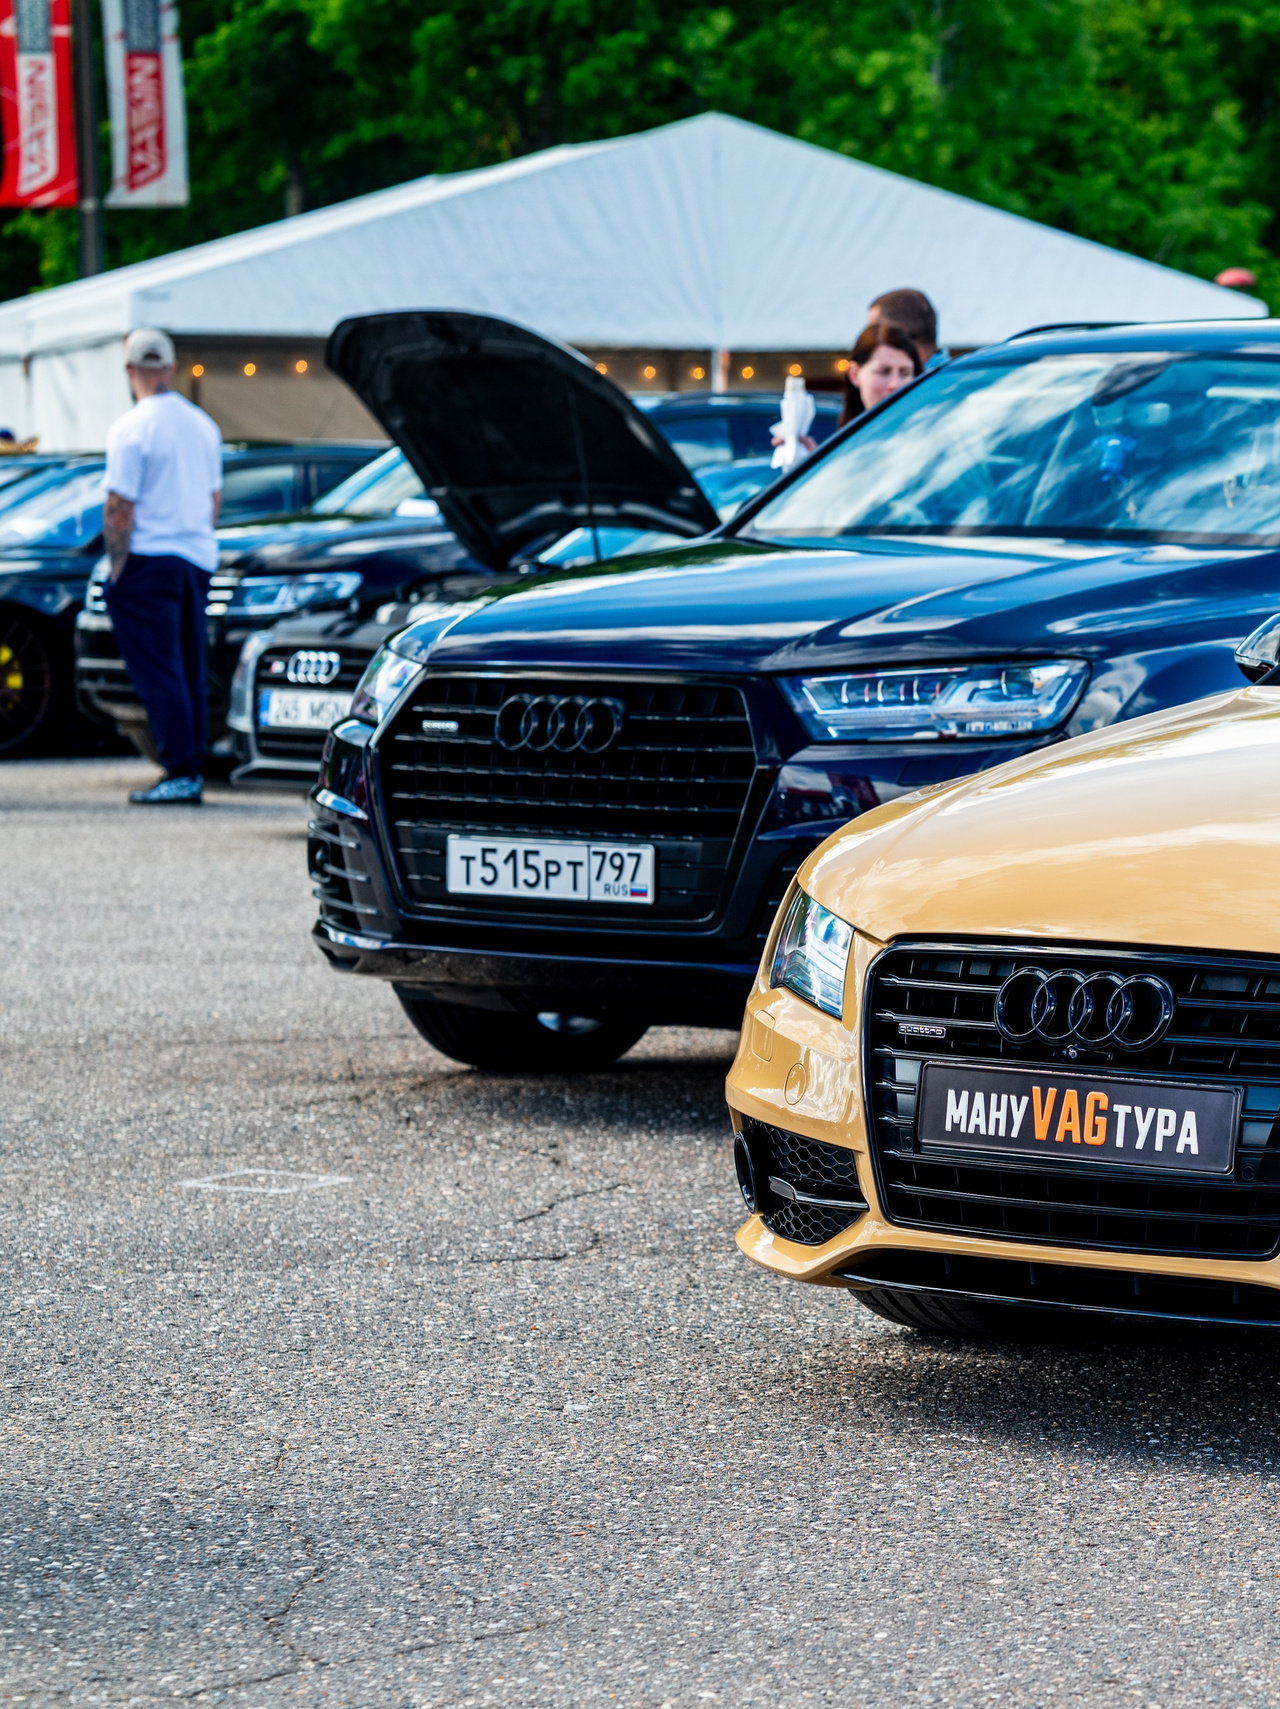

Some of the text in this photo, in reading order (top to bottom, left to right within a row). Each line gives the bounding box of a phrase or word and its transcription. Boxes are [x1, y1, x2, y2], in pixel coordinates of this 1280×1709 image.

[592, 851, 642, 882] 797
[603, 883, 628, 896] RUS
[899, 1025, 944, 1036] quattro
